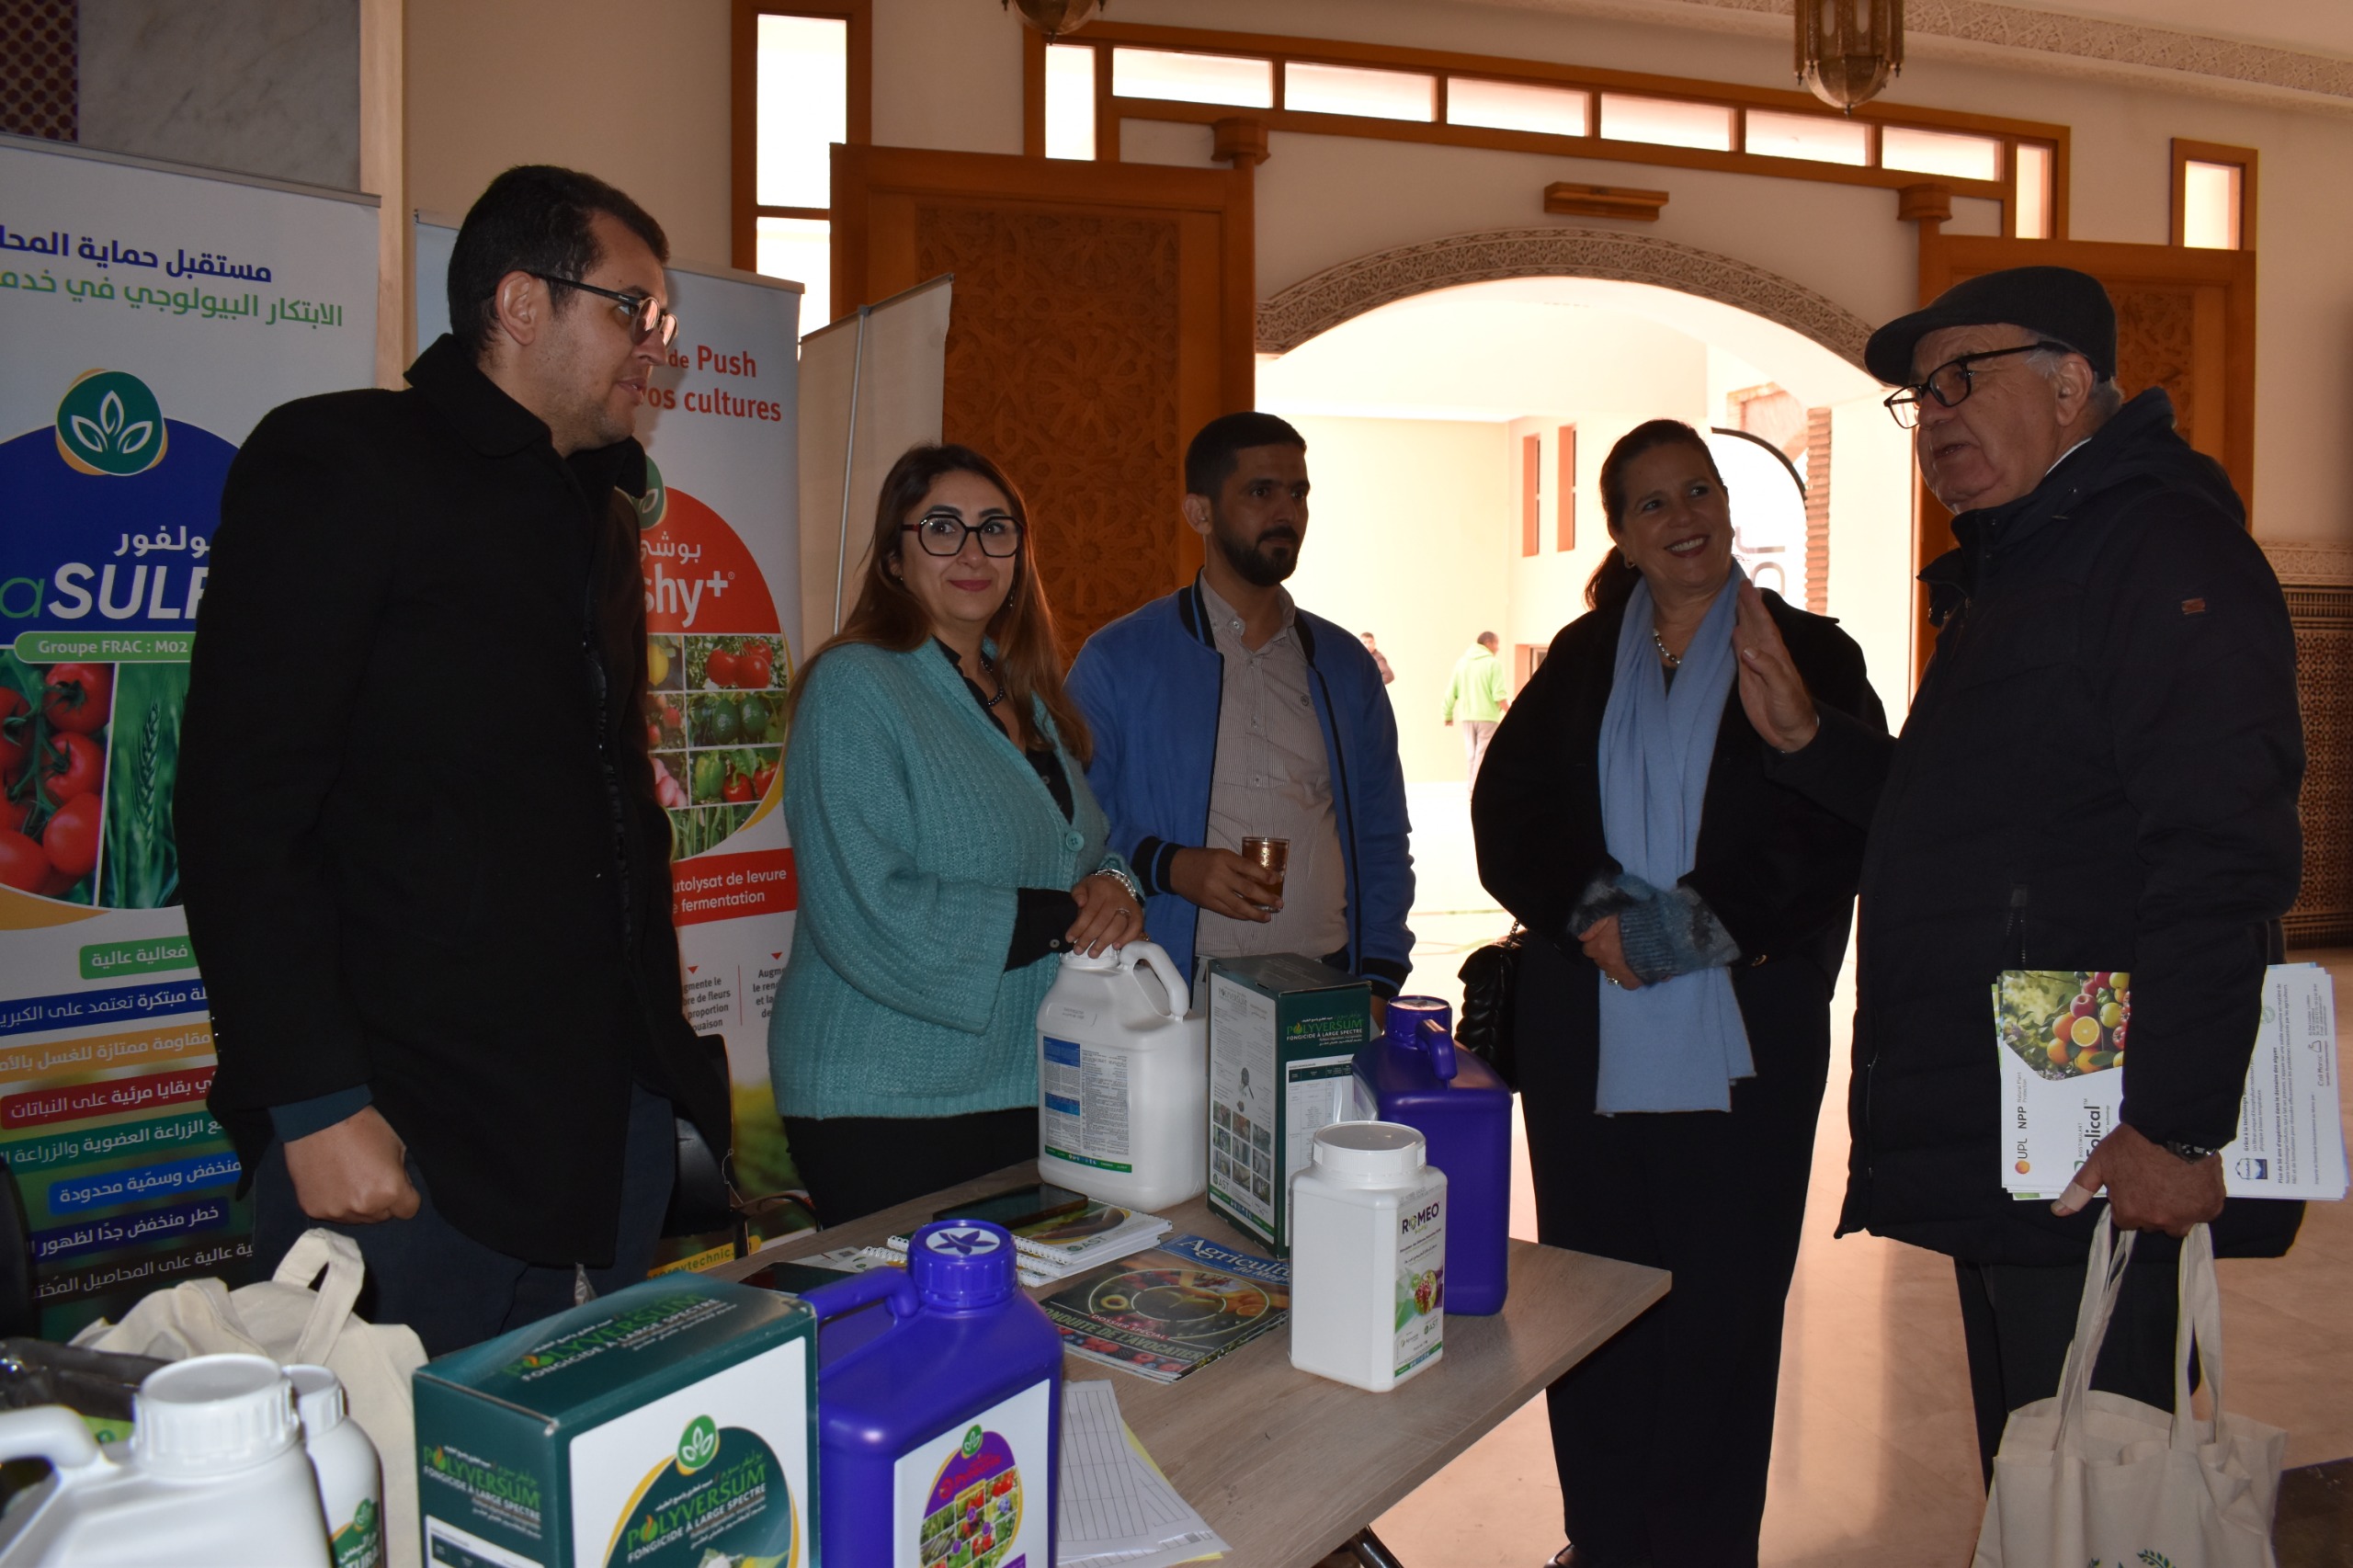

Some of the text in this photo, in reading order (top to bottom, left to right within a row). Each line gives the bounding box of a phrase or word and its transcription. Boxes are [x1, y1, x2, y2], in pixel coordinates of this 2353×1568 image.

[0, 224, 271, 282] مستقبل حماية المحا
[0, 269, 343, 329] الابتكار البيولوجي في خدم
[668, 345, 756, 378] de Push
[644, 387, 781, 422] os cultures
[113, 525, 210, 559] ولفور
[39, 641, 97, 657] Groupe
[101, 641, 142, 653] FRAC
[155, 642, 188, 653] M02
[673, 869, 787, 893] utolysat de levure
[681, 891, 766, 913] fermentation
[91, 944, 188, 969] فعالية عالية
[683, 976, 722, 994] gmente le
[753, 983, 761, 993] le
[89, 995, 134, 1013] تعتمد
[138, 990, 187, 1011] مبتكرة
[697, 994, 707, 1004] de
[708, 990, 732, 1002] fleurs
[756, 997, 765, 1006] et
[0, 1006, 42, 1028] الكبري
[48, 1002, 84, 1018] على
[688, 1003, 729, 1020] proportion
[693, 1018, 723, 1031] ouaison
[1287, 1018, 1364, 1035] POLYVERSUM
[1287, 1033, 1315, 1041] FONGICIDE
[1322, 1029, 1338, 1038] LARGE
[0, 1033, 210, 1072] مقاومة ممتازة للغسل بالأم
[73, 1092, 108, 1110] على
[111, 1085, 153, 1106] مرئية
[157, 1080, 191, 1100] بقايا
[10, 1096, 67, 1119] النباتات
[83, 1128, 150, 1154] العضوية
[153, 1119, 203, 1142] الزراعة
[2017, 1106, 2028, 1159] UPL NPP
[15, 1141, 79, 1164] والزراعة
[186, 1160, 242, 1183] منخفض
[60, 1182, 122, 1205] محدودة
[127, 1215, 184, 1239] منخفض
[188, 1206, 219, 1227] خطر
[1402, 1201, 1439, 1234] ROMEO
[40, 1229, 93, 1256] لظهور
[1082, 1235, 1107, 1247] AST
[158, 1255, 191, 1274] على
[195, 1247, 232, 1267] عالية
[1176, 1239, 1290, 1277] Agricult
[83, 1260, 154, 1292] المحاصيل
[1091, 1314, 1130, 1329] DOSSIER
[521, 1346, 605, 1381] FONGICIDE
[618, 1323, 664, 1343] LARGE
[663, 1298, 721, 1324] SPECTRE
[1098, 1327, 1120, 1339] DE
[1117, 1334, 1205, 1360] L'AVOCATIER
[424, 1446, 541, 1510] POLYVERSUM
[423, 1465, 467, 1491] FONGICIDE
[474, 1488, 503, 1506] LARGE
[503, 1499, 541, 1521] SPECTRE
[627, 1461, 767, 1551] POLYVERSUM
[627, 1526, 685, 1564] FONGICIDE
[694, 1505, 725, 1528] LARGE
[726, 1482, 767, 1511] SPECTRE
